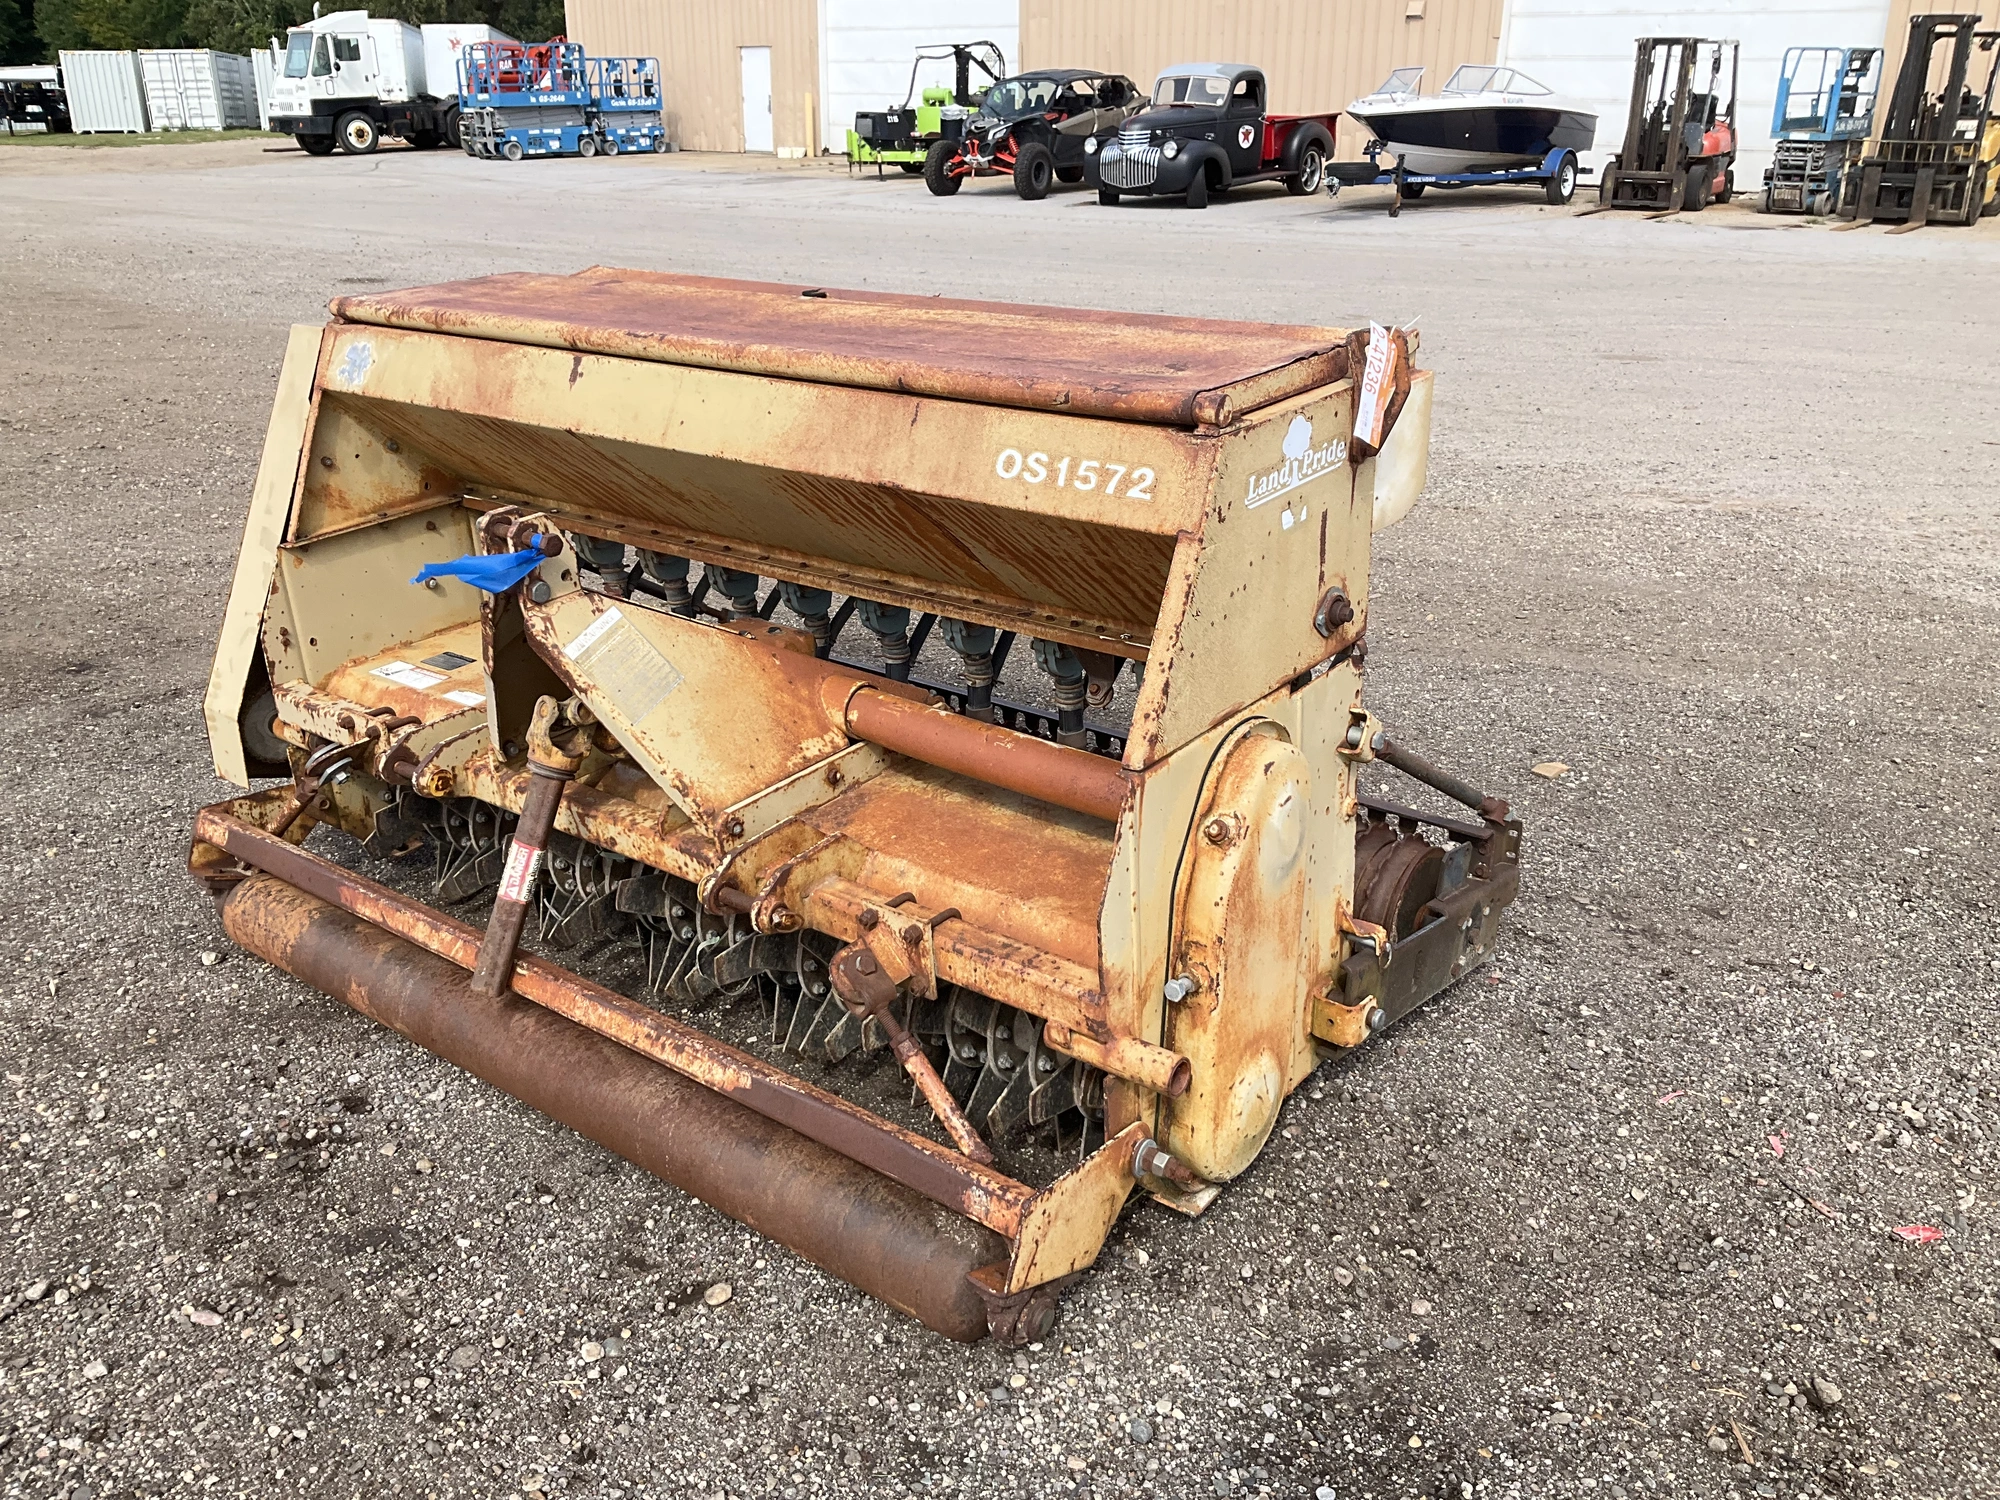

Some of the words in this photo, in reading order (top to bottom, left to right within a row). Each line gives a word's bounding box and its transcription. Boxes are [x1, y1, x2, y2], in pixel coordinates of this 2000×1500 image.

[1364, 326, 1386, 395] 2-41236
[996, 448, 1155, 500] OS1572
[1245, 460, 1291, 503] Land
[1299, 438, 1346, 478] Pride
[508, 847, 530, 886] DANGER
